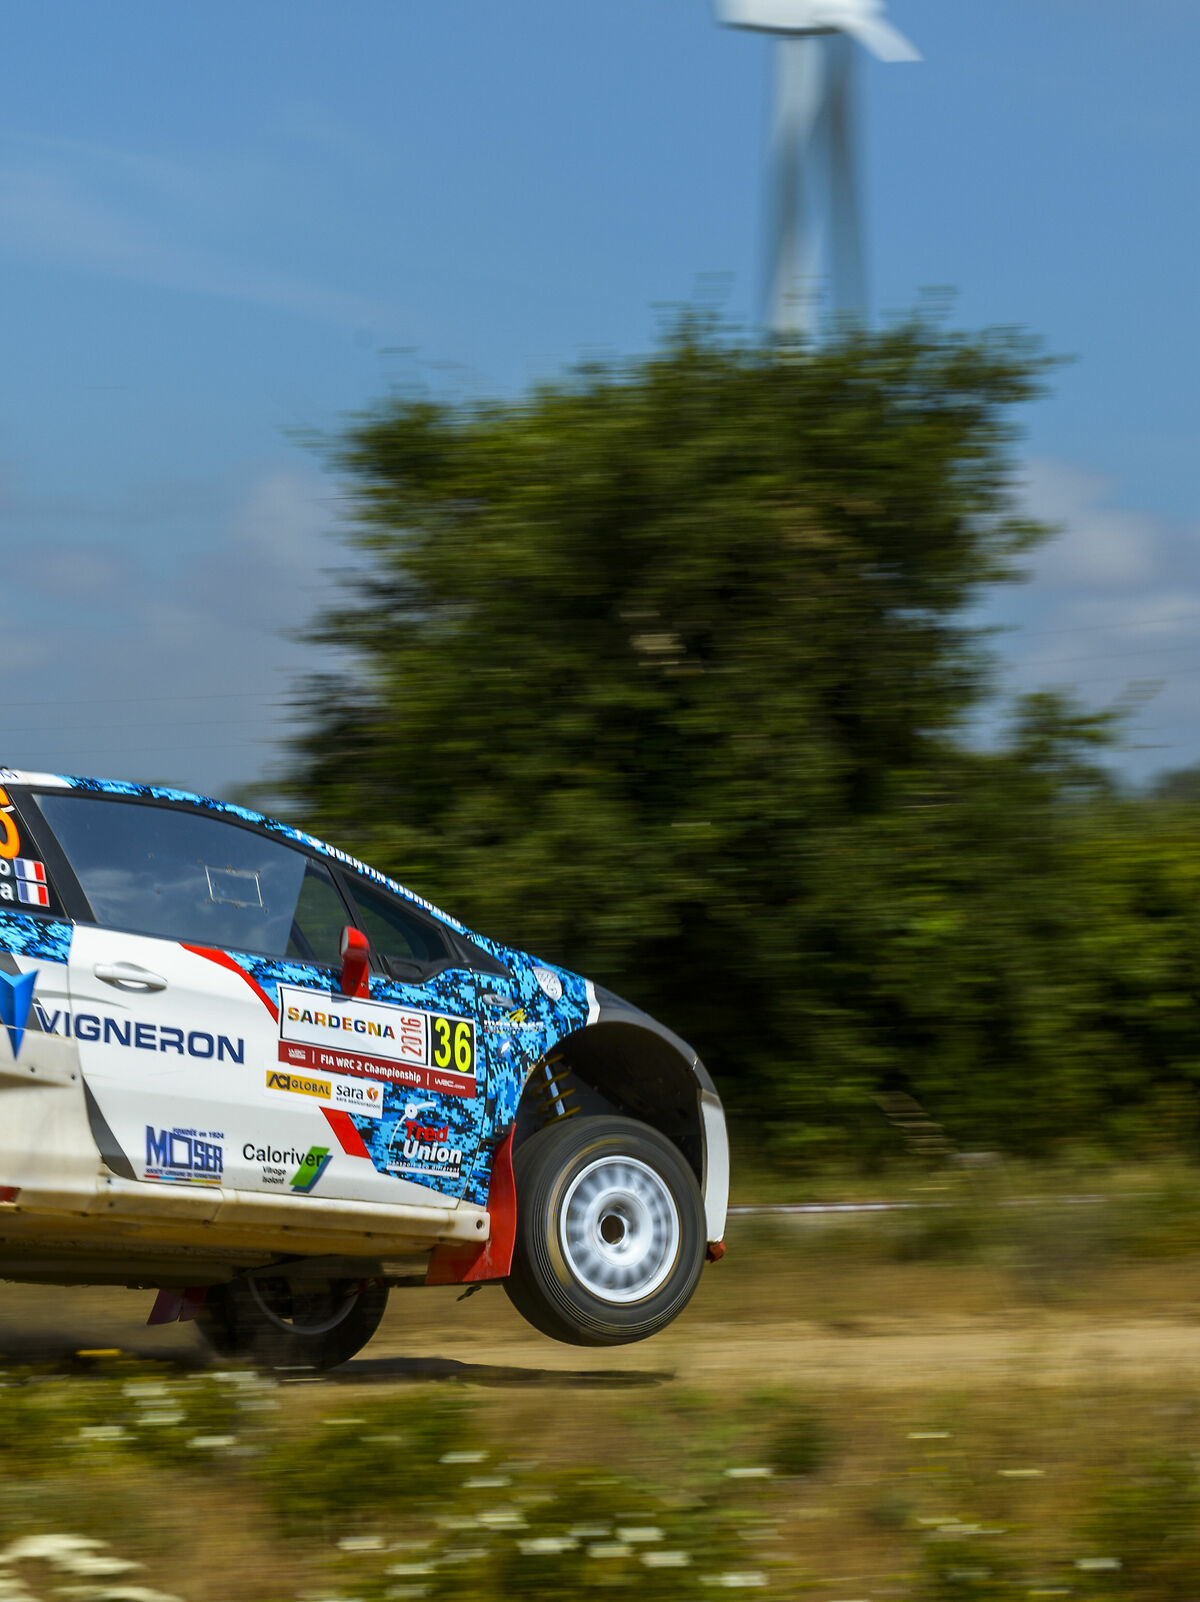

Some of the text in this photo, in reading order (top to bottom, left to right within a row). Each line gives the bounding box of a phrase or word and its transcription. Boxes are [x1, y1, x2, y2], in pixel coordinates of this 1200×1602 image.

[34, 1004, 245, 1065] VIGNERON
[287, 1006, 395, 1040] SARDEGNA
[401, 1017, 422, 1057] 2016
[434, 1017, 472, 1073] 36
[320, 1054, 334, 1066] FIA
[336, 1056, 354, 1070] WRC
[356, 1061, 363, 1072] 2
[364, 1063, 421, 1084] Championship
[291, 1080, 330, 1095] GLOBAL
[336, 1085, 364, 1100] sara
[405, 1120, 449, 1142] Tred
[146, 1125, 223, 1173] MOSER
[243, 1143, 324, 1167] Caloriver
[403, 1139, 462, 1164] Union
